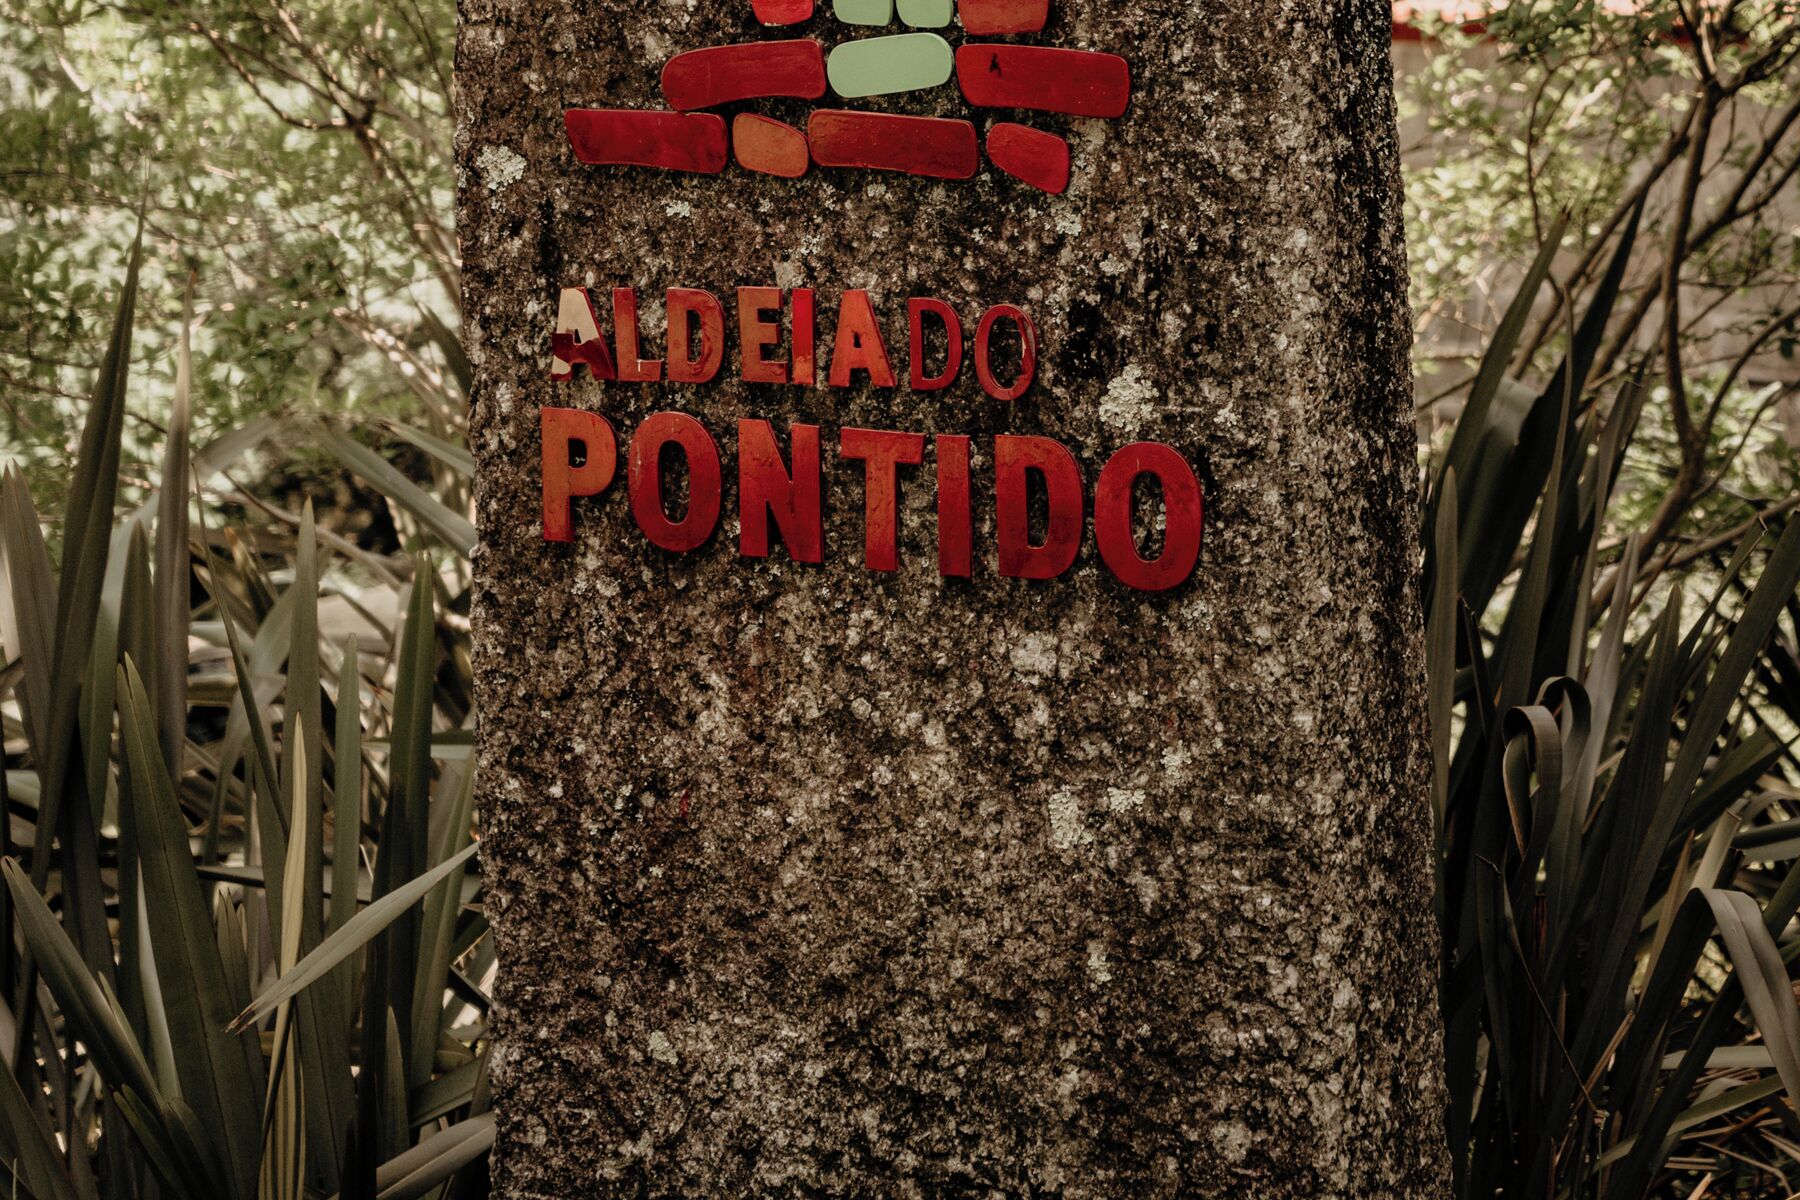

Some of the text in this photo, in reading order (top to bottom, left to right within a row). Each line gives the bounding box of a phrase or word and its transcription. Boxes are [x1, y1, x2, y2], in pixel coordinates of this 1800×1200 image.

[551, 286, 1038, 401] ALDEIA DO
[541, 407, 1201, 591] PONTIDO
